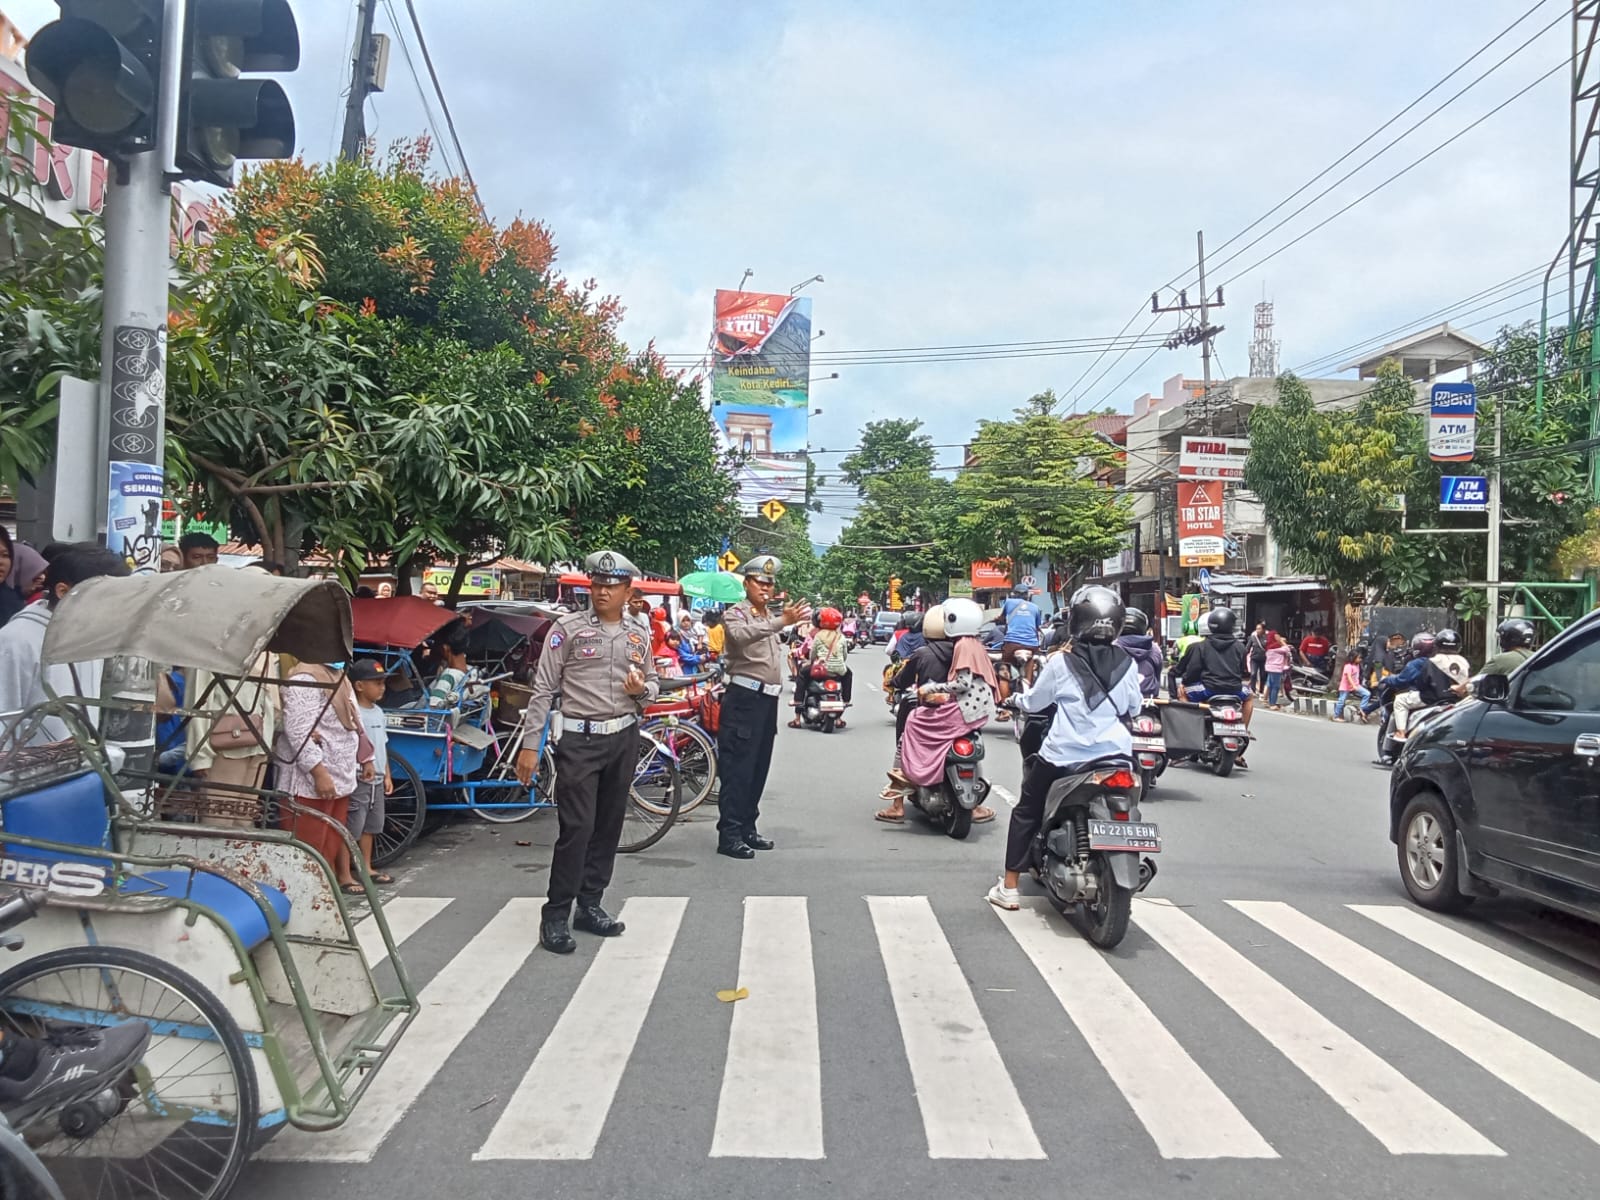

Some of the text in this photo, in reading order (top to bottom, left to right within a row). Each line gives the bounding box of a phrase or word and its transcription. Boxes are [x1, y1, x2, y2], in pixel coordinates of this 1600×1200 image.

[728, 366, 777, 377] Keindahan
[740, 380, 761, 390] Kota
[1439, 424, 1467, 434] ATM
[1457, 481, 1479, 490] ATM
[1463, 491, 1484, 500] BCA
[1181, 506, 1221, 522] TRI STAR
[1093, 823, 1106, 835] AG
[1109, 825, 1134, 836] 2216
